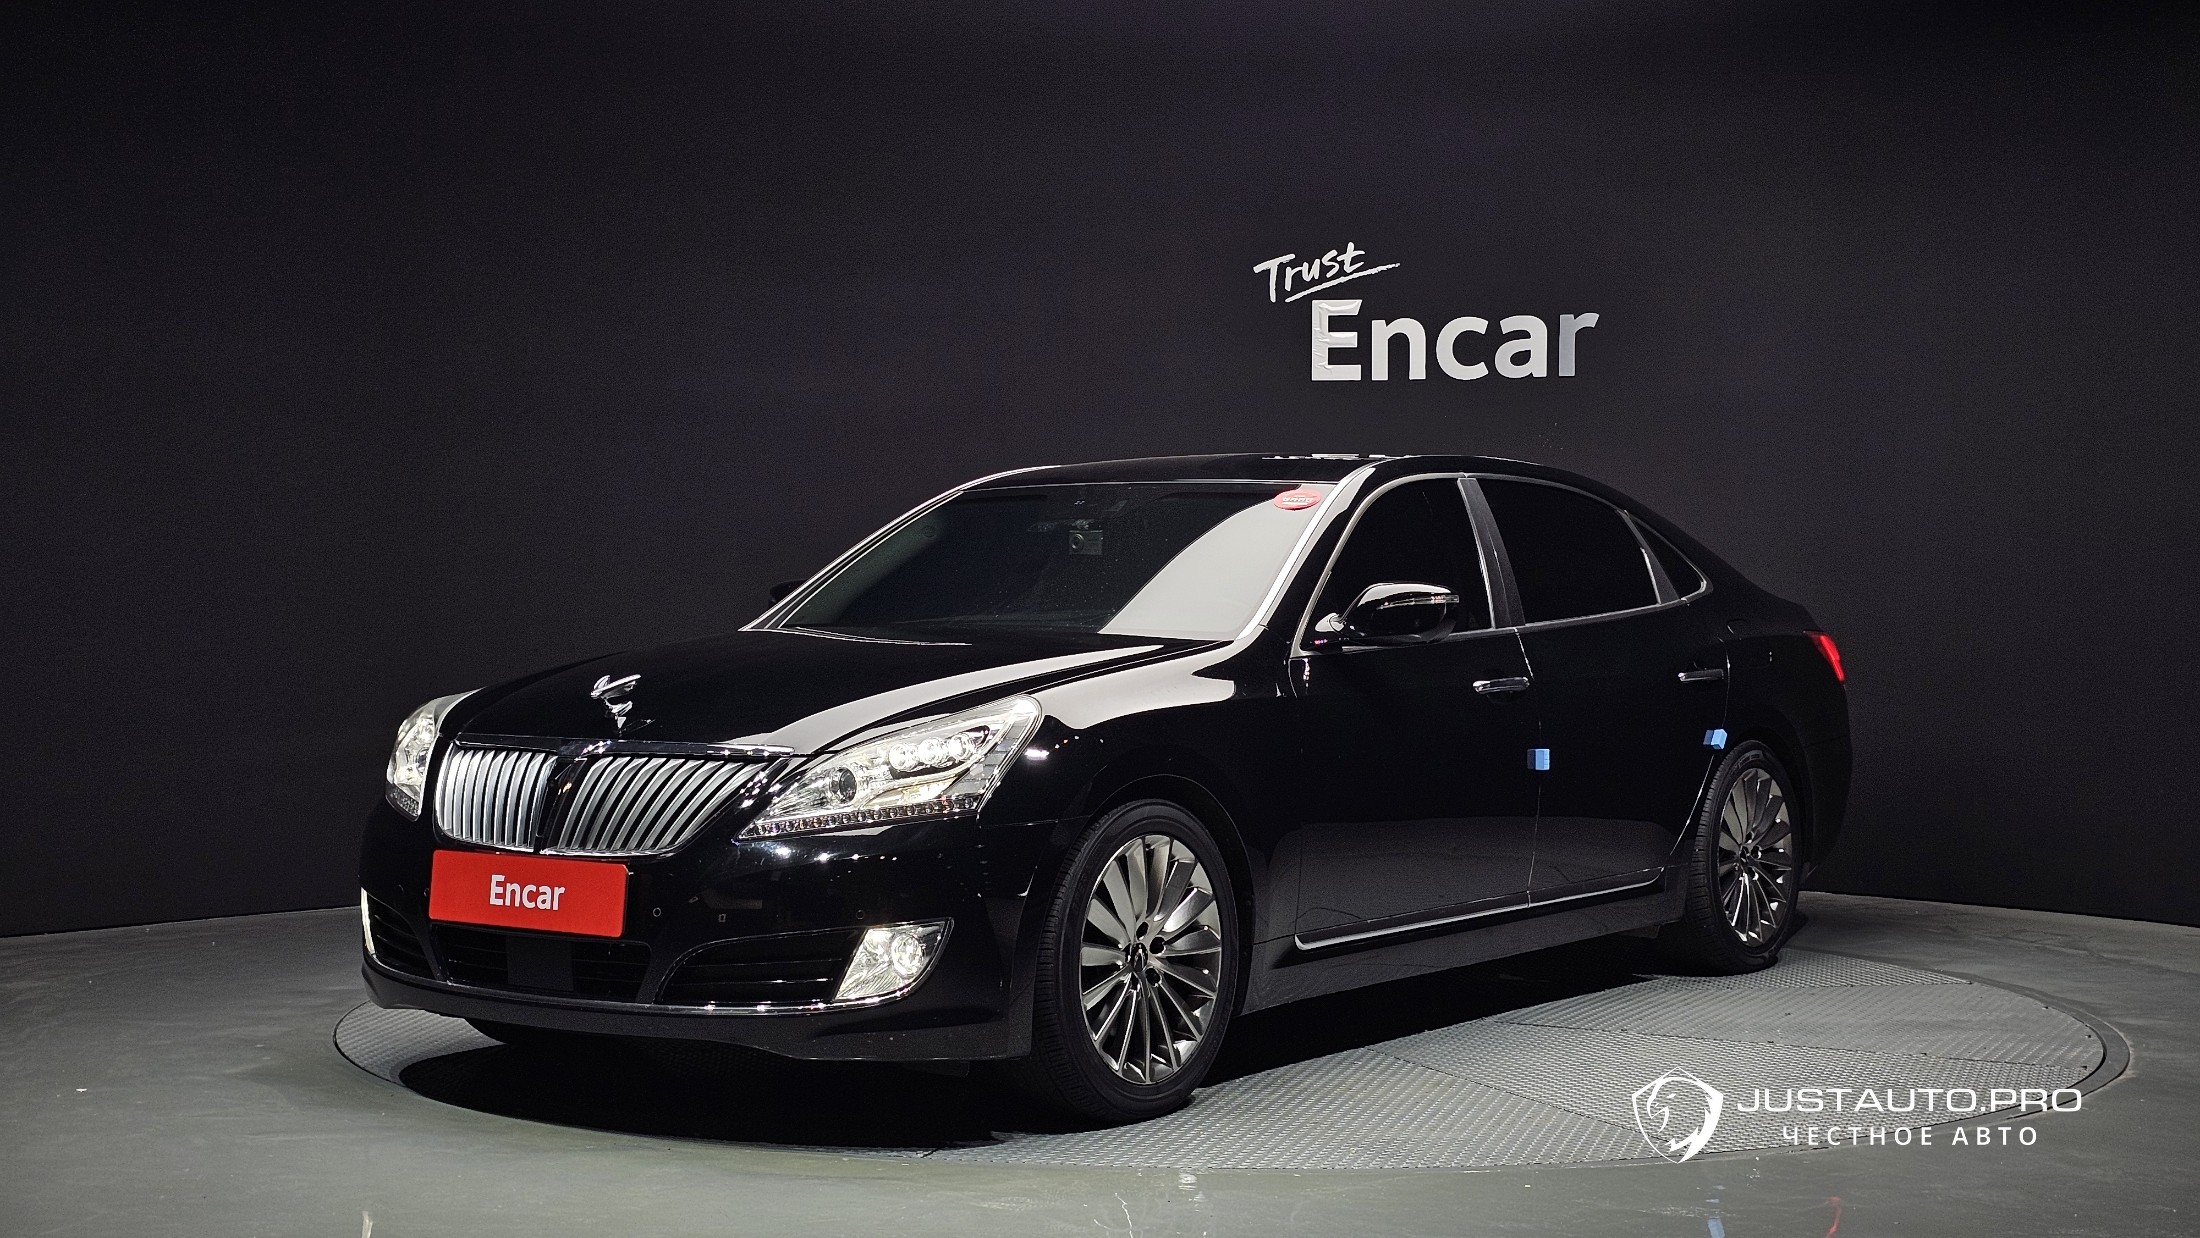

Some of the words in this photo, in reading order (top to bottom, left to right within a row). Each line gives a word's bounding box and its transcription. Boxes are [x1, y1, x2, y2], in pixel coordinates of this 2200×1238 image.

[1253, 242, 1366, 302] Trust
[1311, 299, 1599, 381] Encar
[489, 874, 565, 911] Encar
